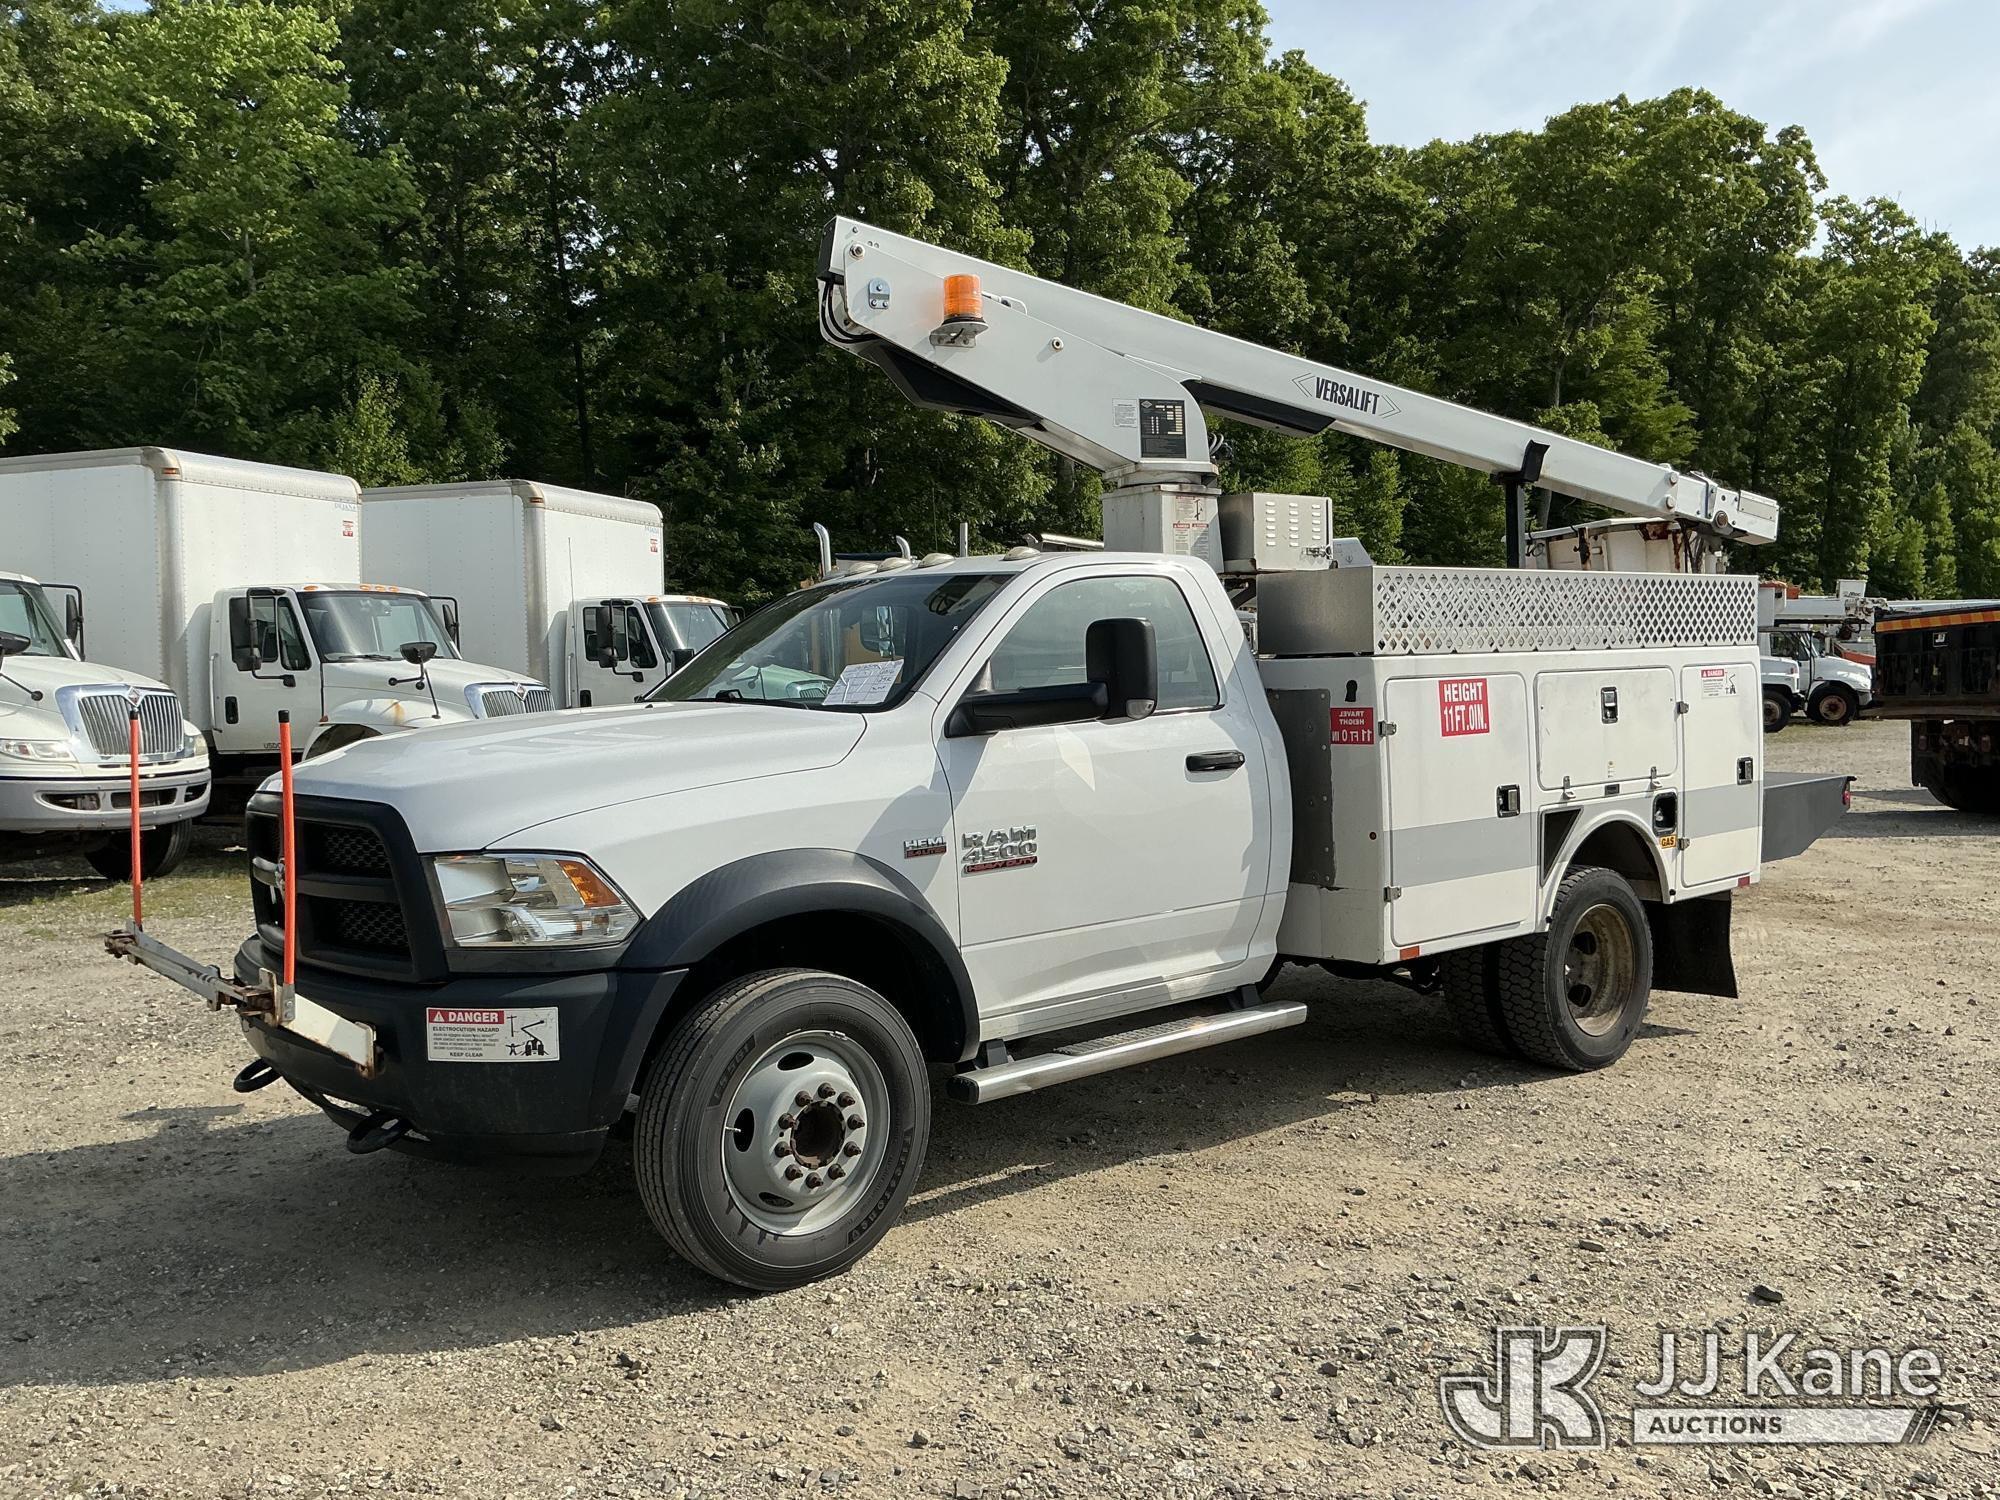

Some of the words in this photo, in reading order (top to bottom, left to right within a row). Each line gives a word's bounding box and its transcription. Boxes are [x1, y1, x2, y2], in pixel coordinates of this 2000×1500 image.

[1315, 377, 1380, 415] VERSALIFT
[1443, 682, 1483, 702] HEIGHT
[962, 825, 1037, 849] RAM
[1661, 837, 1675, 847] GAS
[961, 840, 1038, 862] 4500
[967, 860, 1005, 872] HEAVY
[1006, 856, 1037, 868] DUTY
[447, 1011, 499, 1023] DANGER
